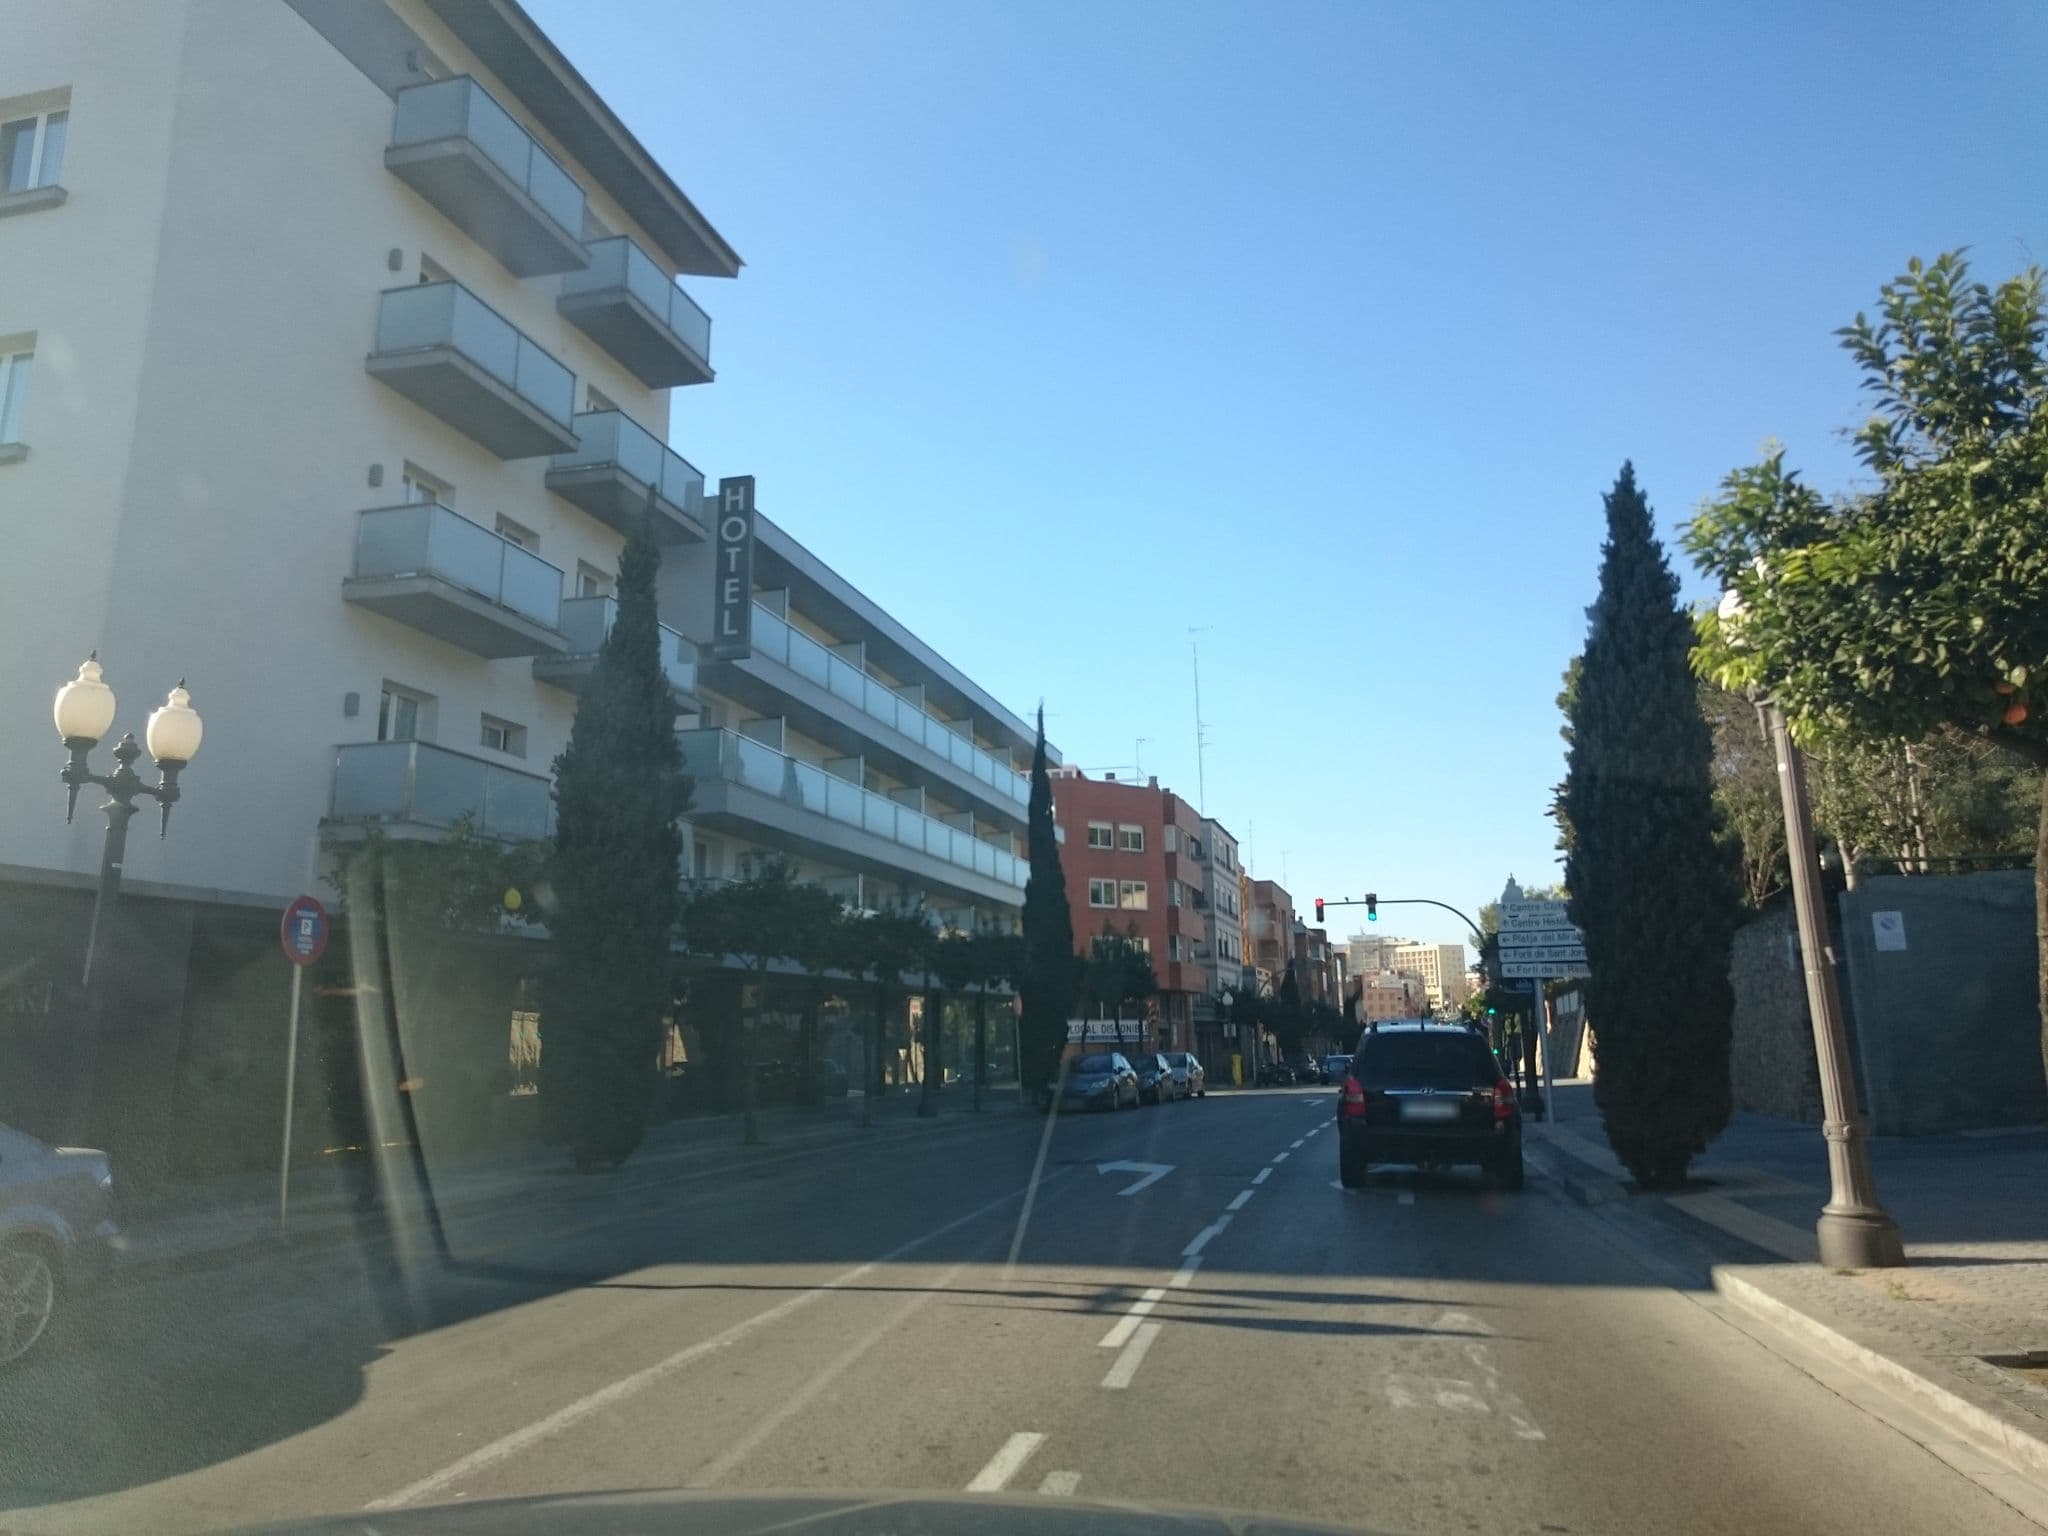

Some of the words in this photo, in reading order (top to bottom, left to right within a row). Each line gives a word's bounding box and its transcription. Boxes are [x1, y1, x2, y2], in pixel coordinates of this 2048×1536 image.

[720, 485, 747, 636] HOTEL
[1509, 903, 1540, 912] Centre
[1511, 918, 1540, 928] Centre
[1512, 934, 1538, 944] Platja
[1541, 933, 1555, 941] del
[1534, 949, 1545, 957] de
[1541, 964, 1553, 973] de
[1101, 1023, 1149, 1034] DISONIBE
